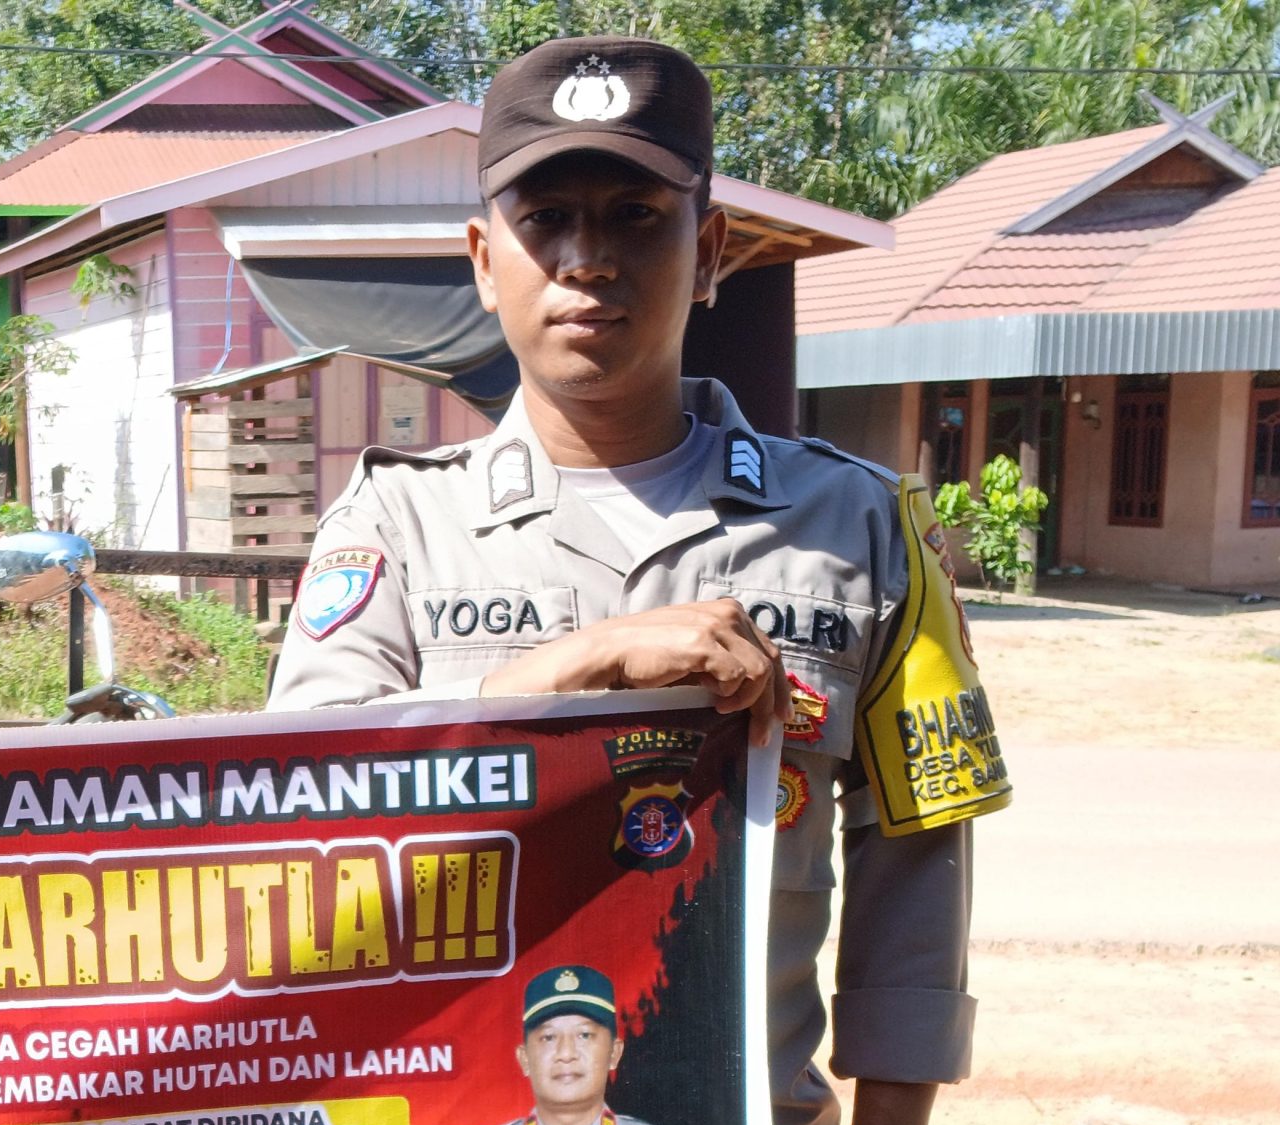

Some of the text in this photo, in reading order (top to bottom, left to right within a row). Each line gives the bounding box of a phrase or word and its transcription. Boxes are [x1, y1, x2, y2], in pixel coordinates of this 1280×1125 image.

[423, 597, 542, 640] YOGA
[748, 601, 848, 651] OLRI
[219, 752, 529, 817] MANTIKEI
[904, 746, 976, 782] DESA
[909, 774, 969, 806] KEC.
[411, 850, 502, 963] !!!
[25, 1026, 139, 1061] CEGAH
[147, 1015, 318, 1054] KARHUTLA
[152, 1058, 260, 1093] HUTAN
[269, 1052, 336, 1083] DAN
[343, 1044, 453, 1077] LAHAN
